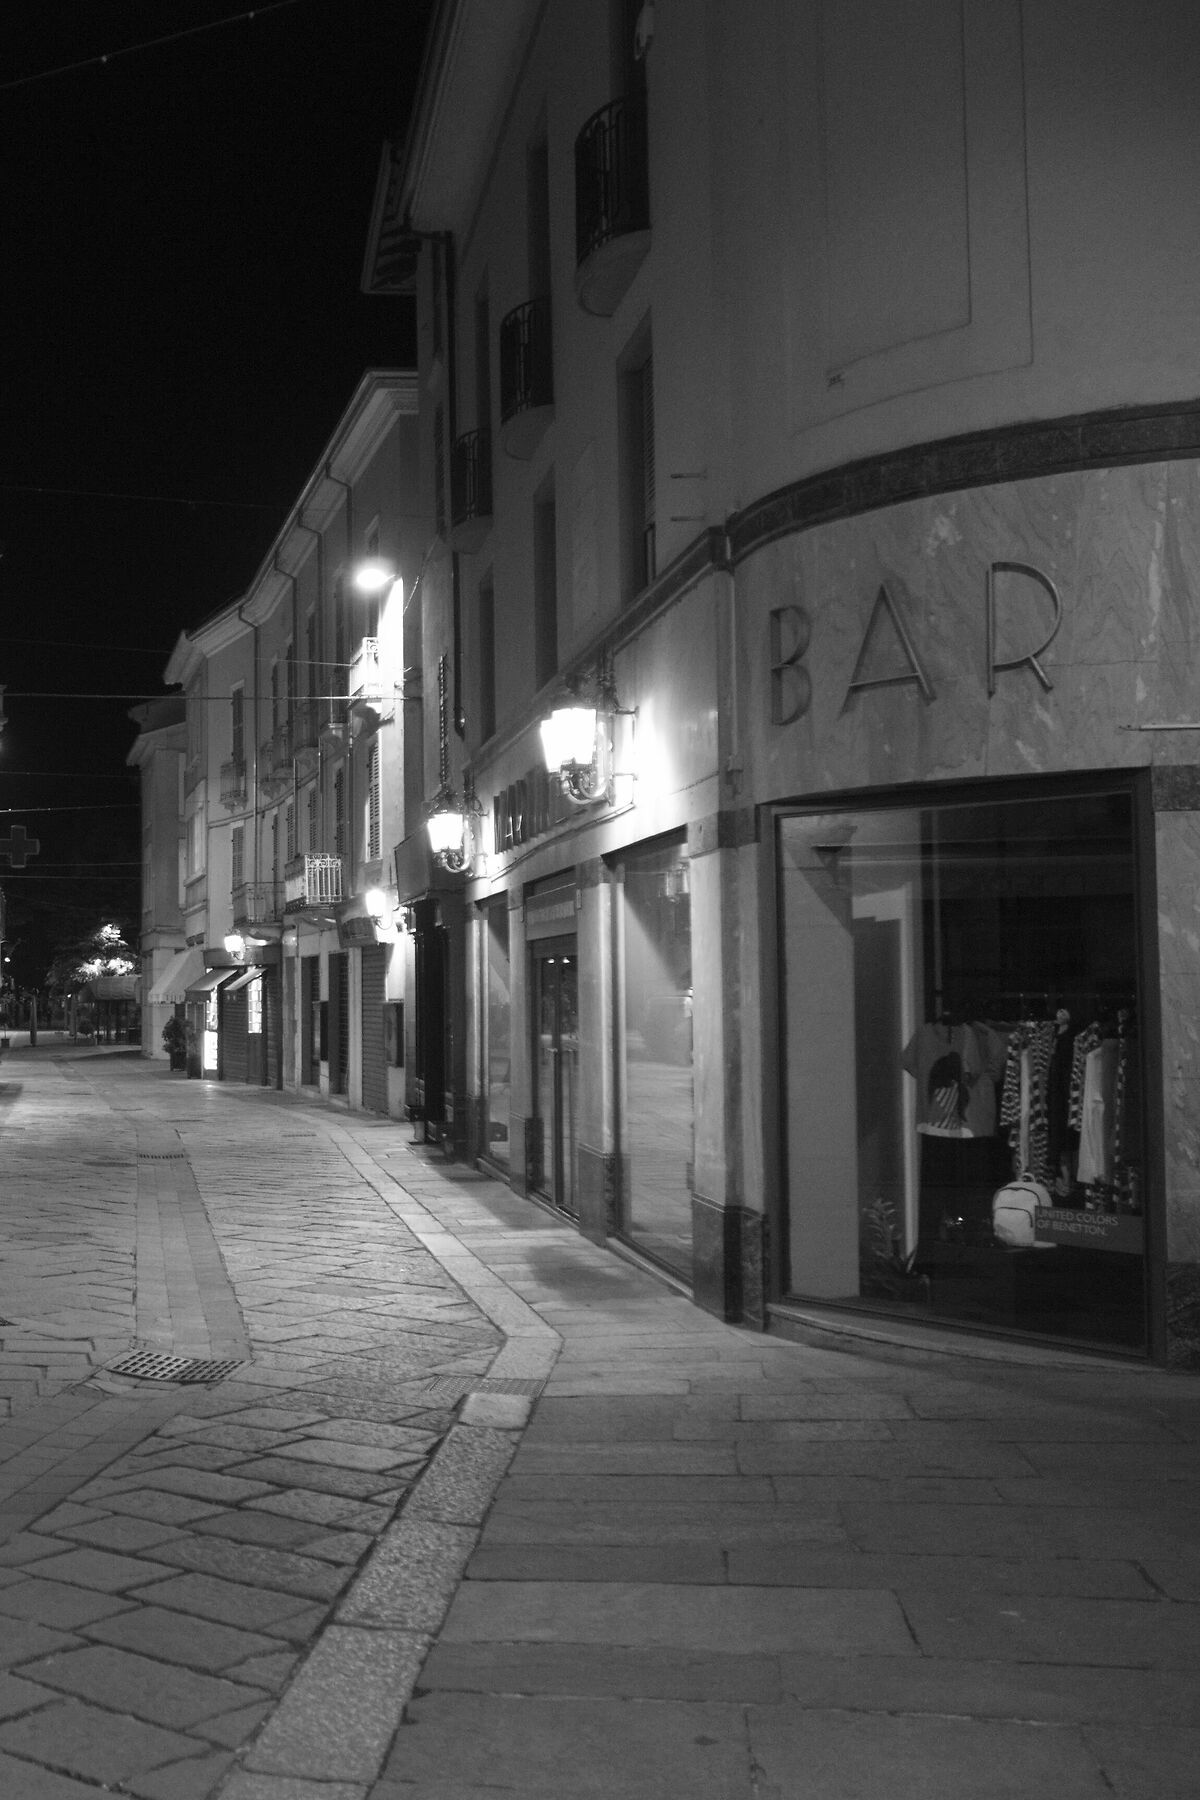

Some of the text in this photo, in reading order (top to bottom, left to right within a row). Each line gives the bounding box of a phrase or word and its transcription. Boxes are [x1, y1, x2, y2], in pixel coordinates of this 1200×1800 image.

[768, 561, 1063, 727] BAR
[1036, 1208, 1119, 1227] UNITED COLORS
[1036, 1219, 1050, 1230] OF
